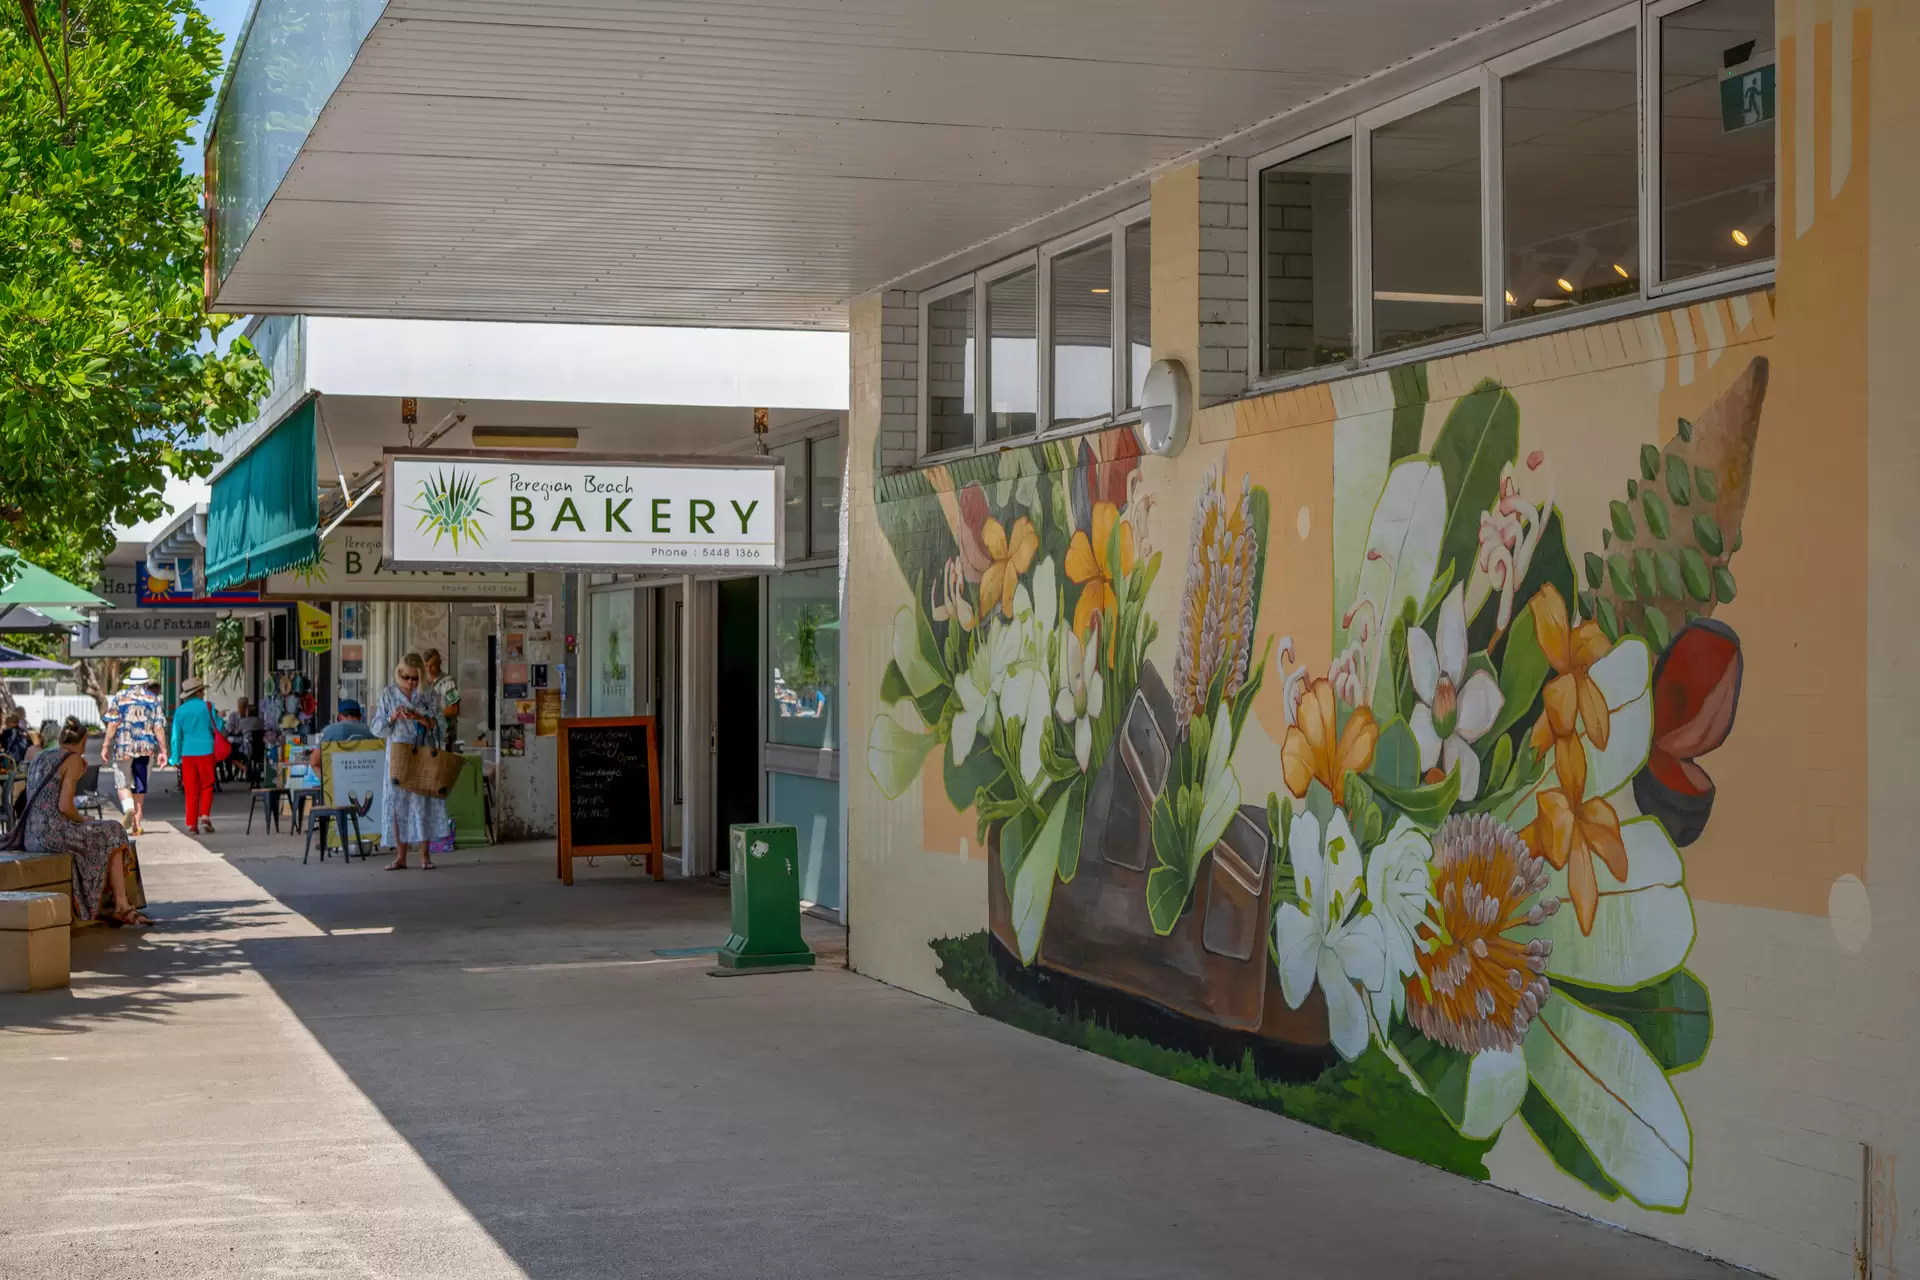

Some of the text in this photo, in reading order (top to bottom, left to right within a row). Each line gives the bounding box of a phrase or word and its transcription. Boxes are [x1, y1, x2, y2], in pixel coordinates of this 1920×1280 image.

[510, 473, 634, 501] Peregian Beach
[510, 496, 760, 535] BAKERY
[651, 547, 688, 558] Phone
[702, 548, 730, 558] 5448
[735, 547, 760, 558] 1366
[144, 618, 160, 631] Of
[163, 618, 211, 630] Fatima
